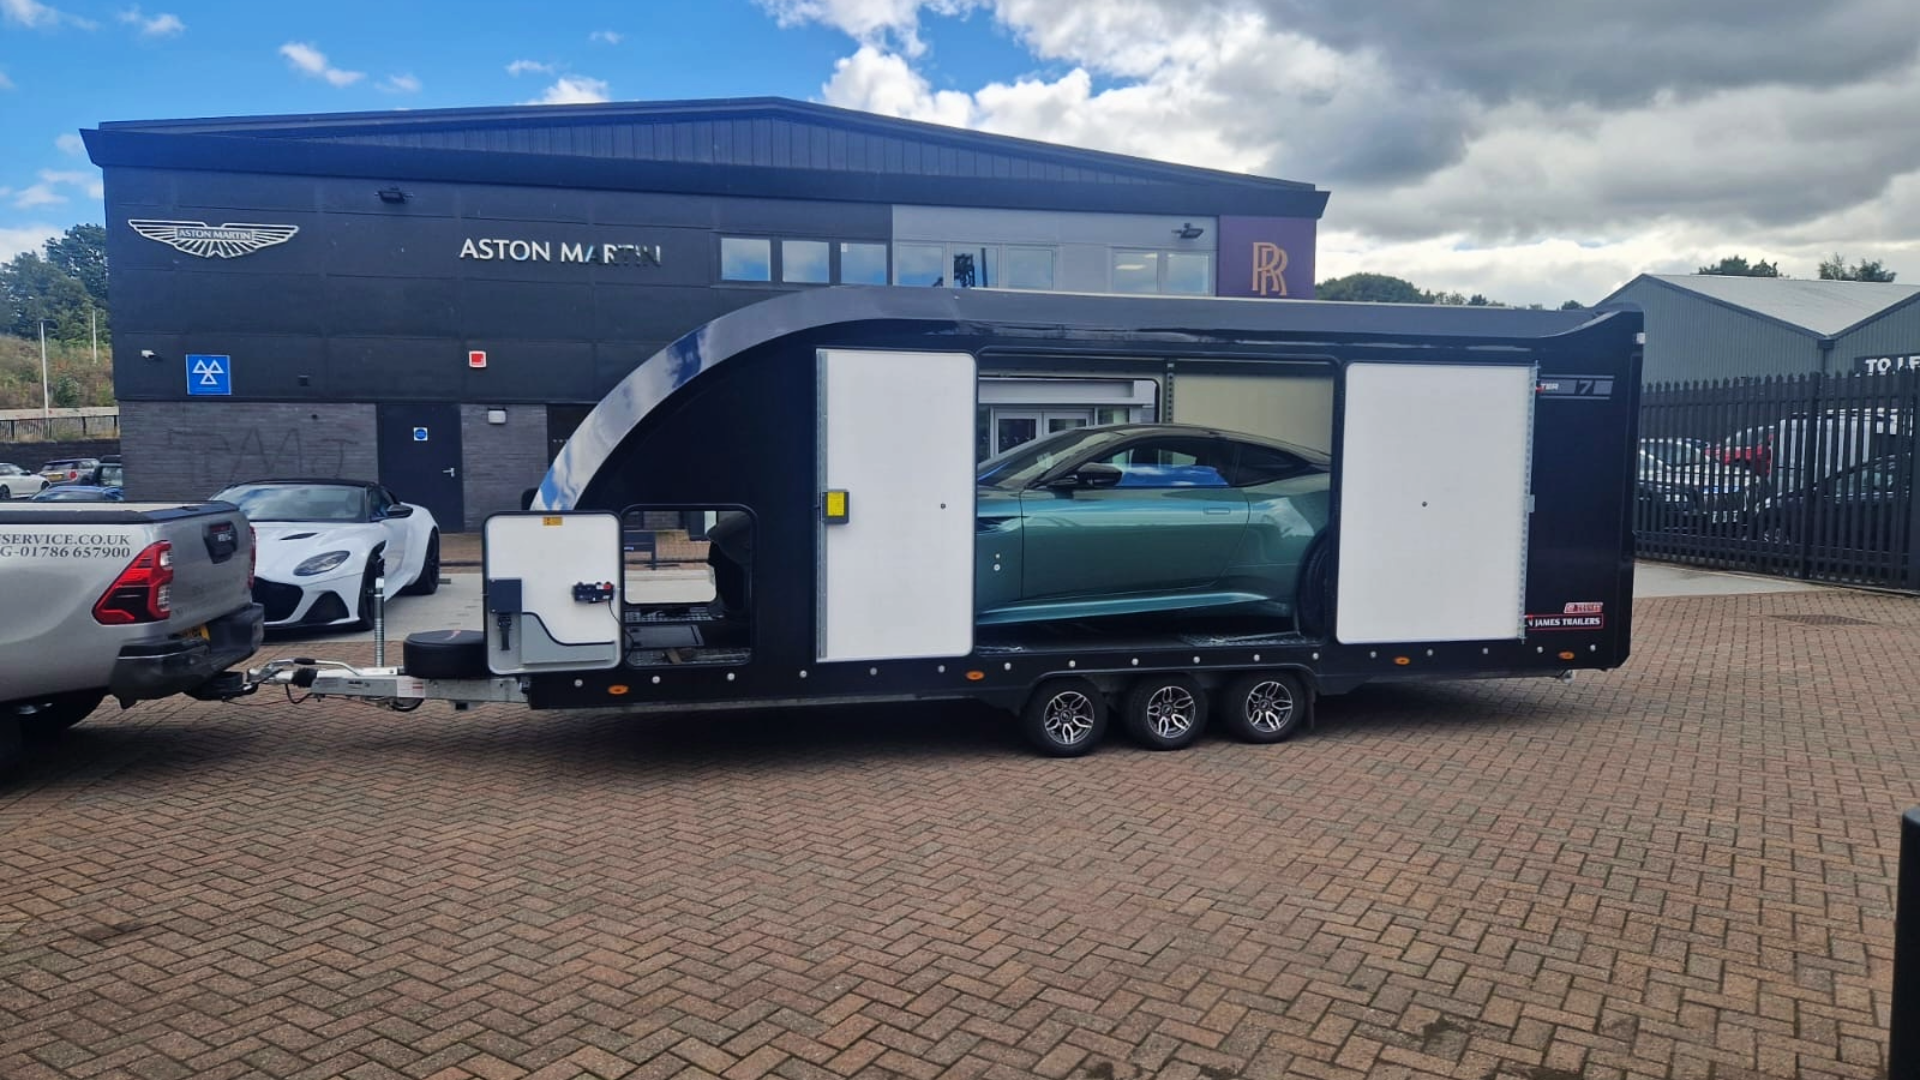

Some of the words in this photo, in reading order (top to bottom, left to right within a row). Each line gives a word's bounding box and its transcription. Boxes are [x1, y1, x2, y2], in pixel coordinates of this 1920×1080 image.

[178, 229, 212, 239] ASTON
[213, 231, 251, 240] MARTIN
[459, 238, 550, 261] ASTON
[560, 242, 662, 265] MARTIN
[1865, 357, 1892, 377] TO
[0, 534, 131, 545] SERVICE.CO.UK
[0, 546, 69, 558] G-01786
[72, 547, 131, 558] 657900
[1535, 618, 1561, 627] JAMES
[1562, 617, 1601, 626] TRAILERS
